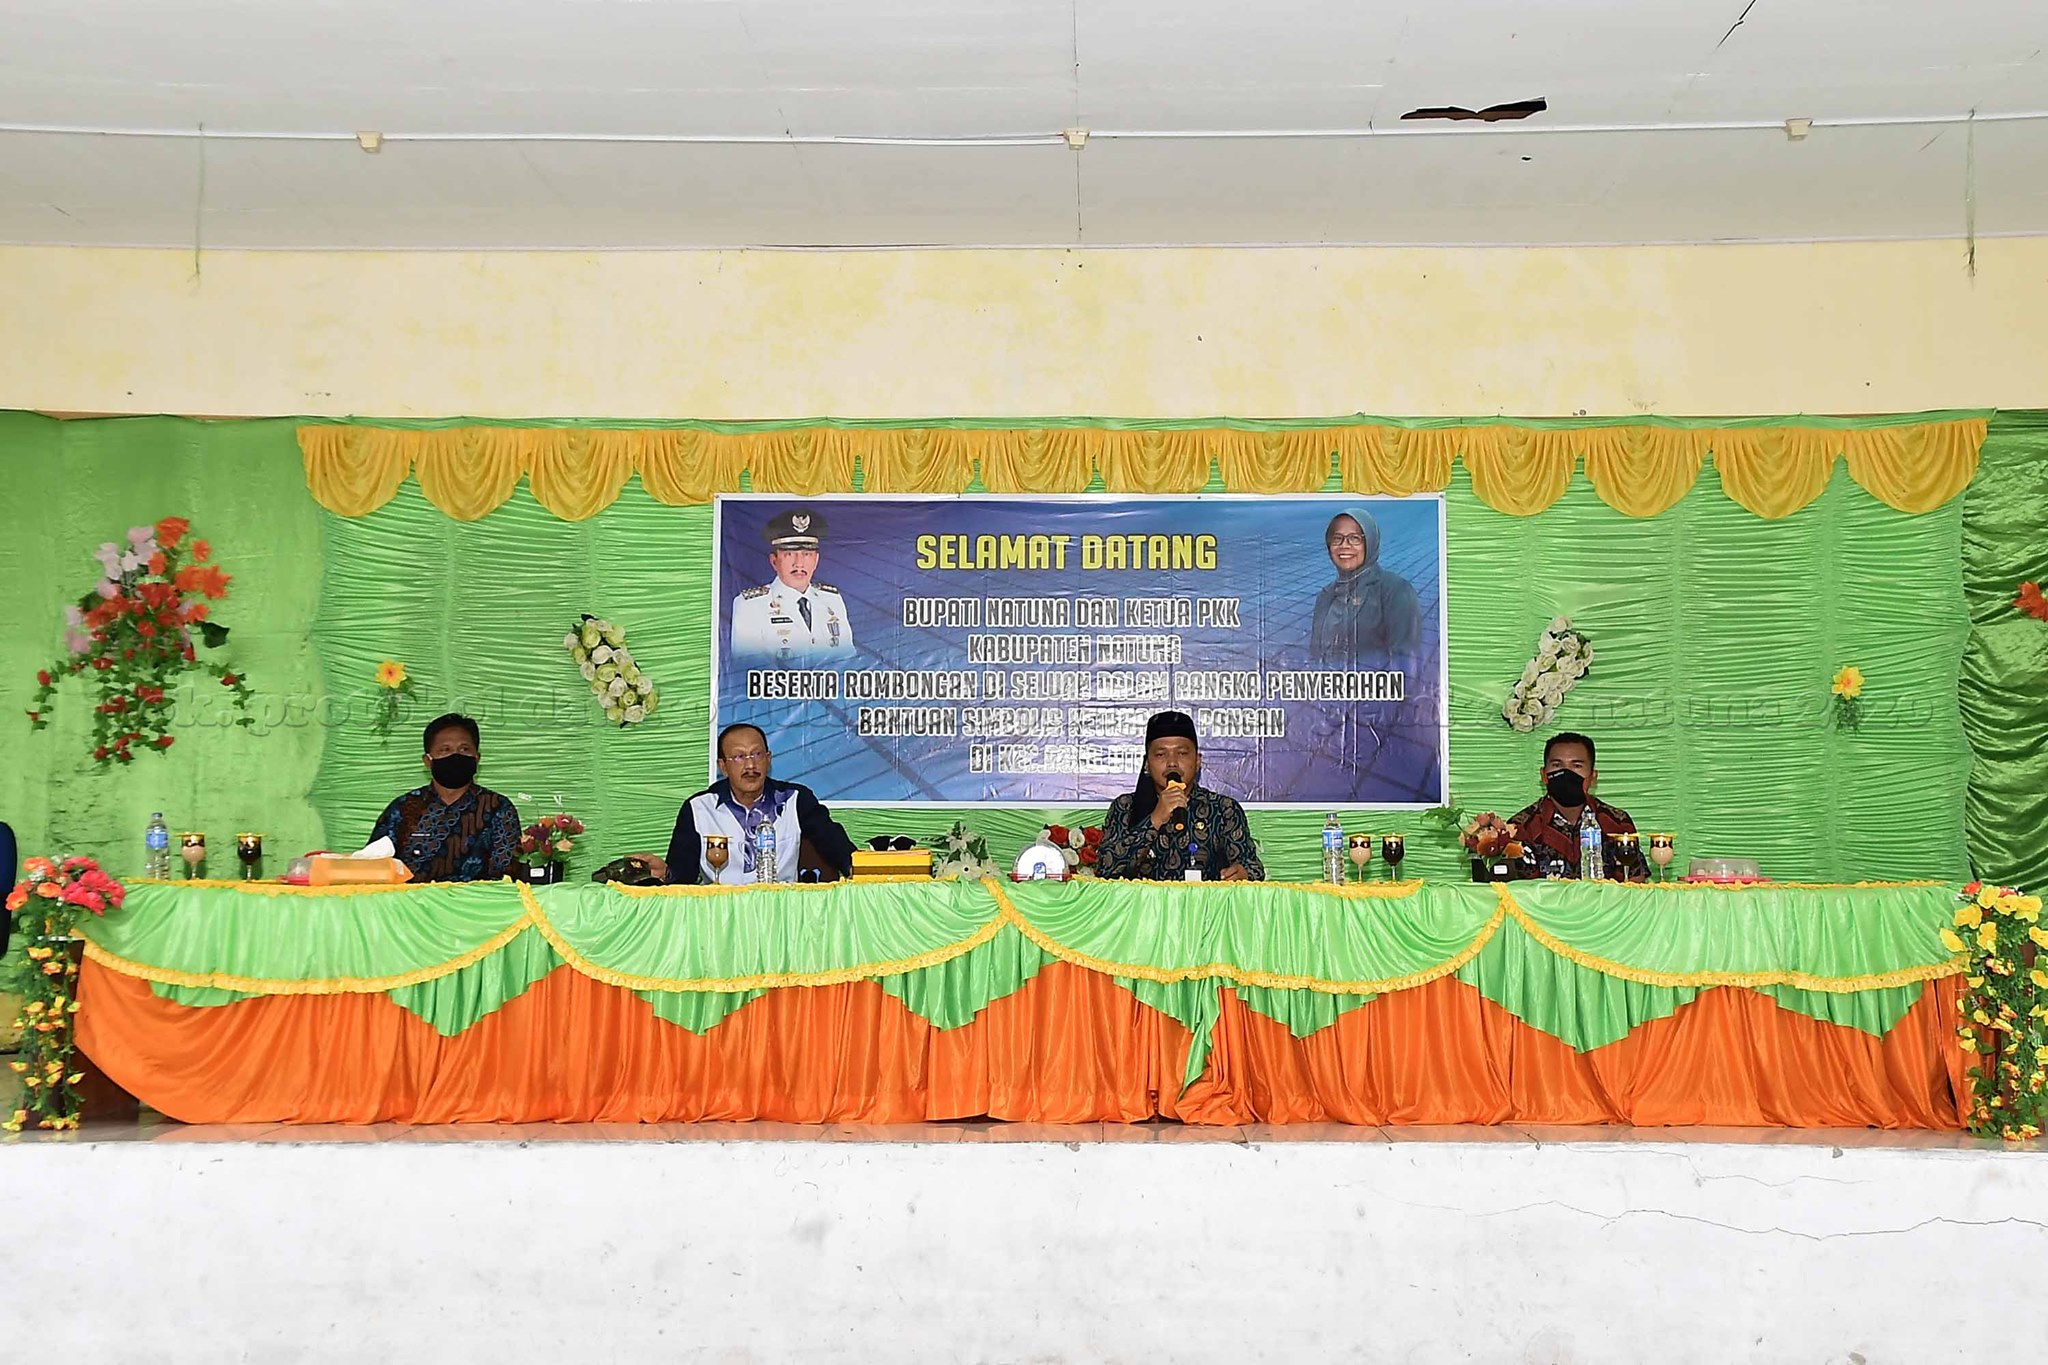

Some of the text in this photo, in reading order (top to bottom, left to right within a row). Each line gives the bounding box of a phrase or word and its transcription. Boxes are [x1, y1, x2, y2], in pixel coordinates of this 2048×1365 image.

[915, 534, 1217, 570] SELAMAT DATANG
[904, 598, 1240, 627] BUPATI NATUNA DAN KETUA PKK
[968, 634, 1181, 664] KABUPATEN NATUNA
[748, 670, 1404, 701] BESERTA ROMBONGAN DI SELUAN DALAM RANGKA PENYERAHAN
[858, 707, 957, 736] BANTUAN
[962, 707, 1062, 737] SIMBOLIS
[1198, 708, 1285, 737] PANGAN
[969, 744, 992, 773] DI
